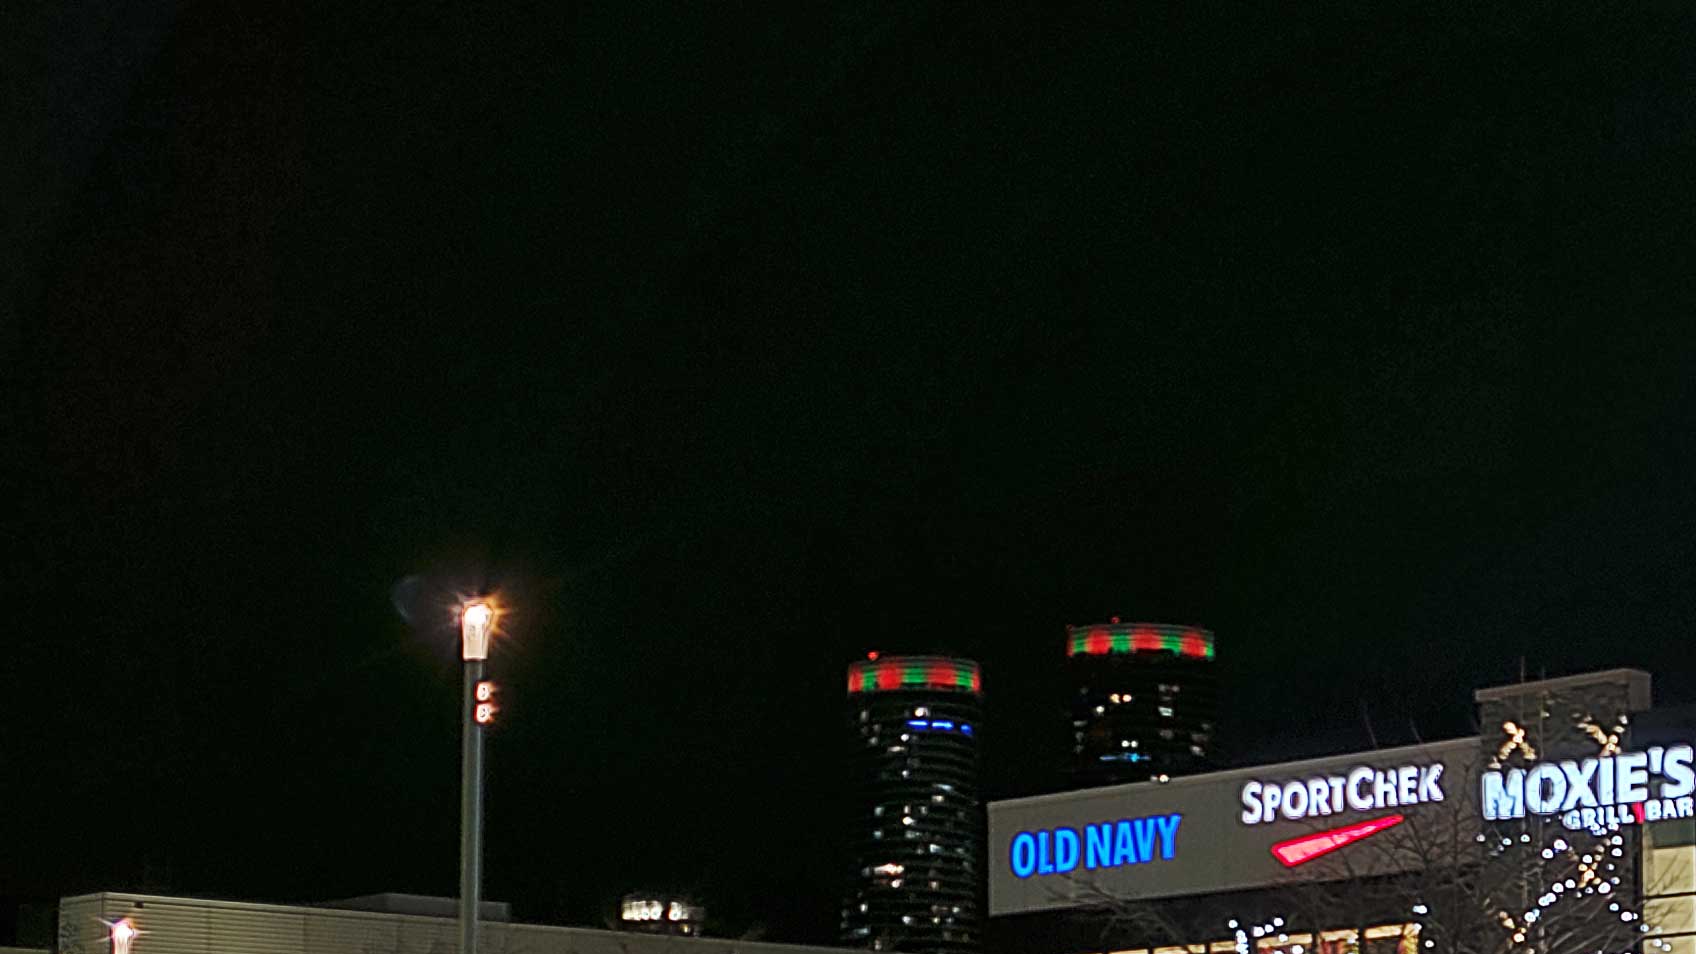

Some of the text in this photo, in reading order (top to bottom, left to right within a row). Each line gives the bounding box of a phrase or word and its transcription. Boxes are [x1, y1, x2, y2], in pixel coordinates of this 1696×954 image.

[1482, 745, 1696, 820] MOXIE'S
[1562, 797, 1695, 831] GRILL BAR
[1011, 813, 1183, 878] OLD NAVY
